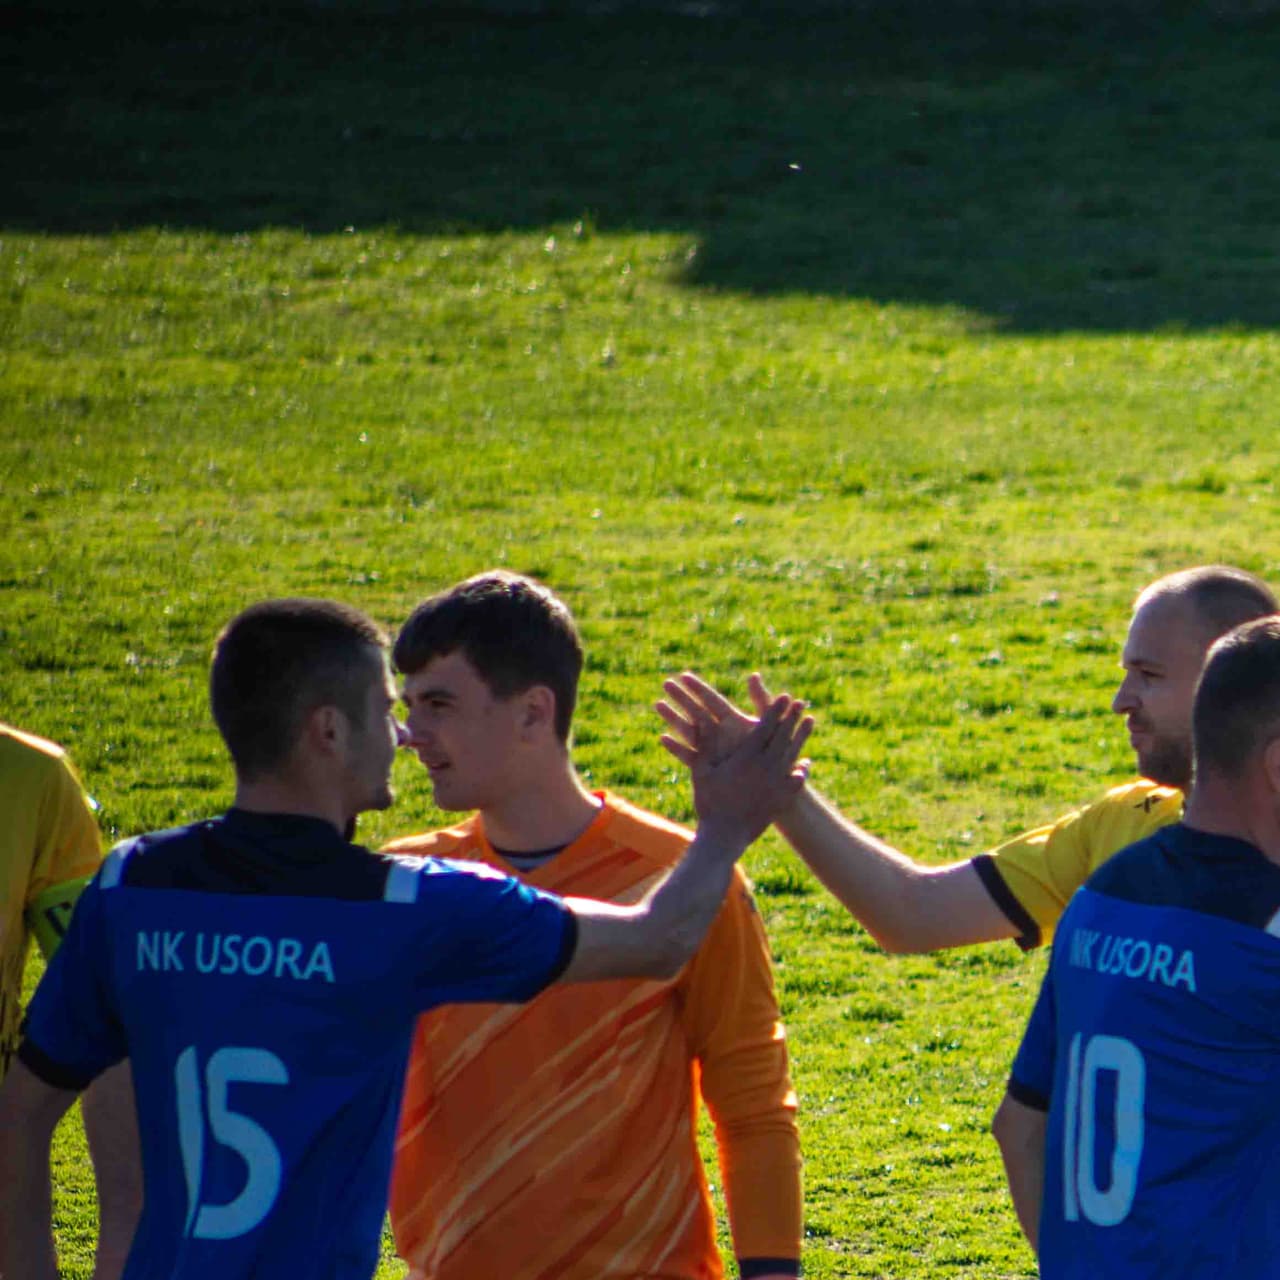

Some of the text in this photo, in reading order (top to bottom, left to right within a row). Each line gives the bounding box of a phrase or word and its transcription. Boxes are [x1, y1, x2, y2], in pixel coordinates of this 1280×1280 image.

[136, 931, 336, 983] NK USORA
[1069, 928, 1197, 993] NK USORA
[174, 1046, 289, 1240] 15
[1064, 1032, 1146, 1227] 10
